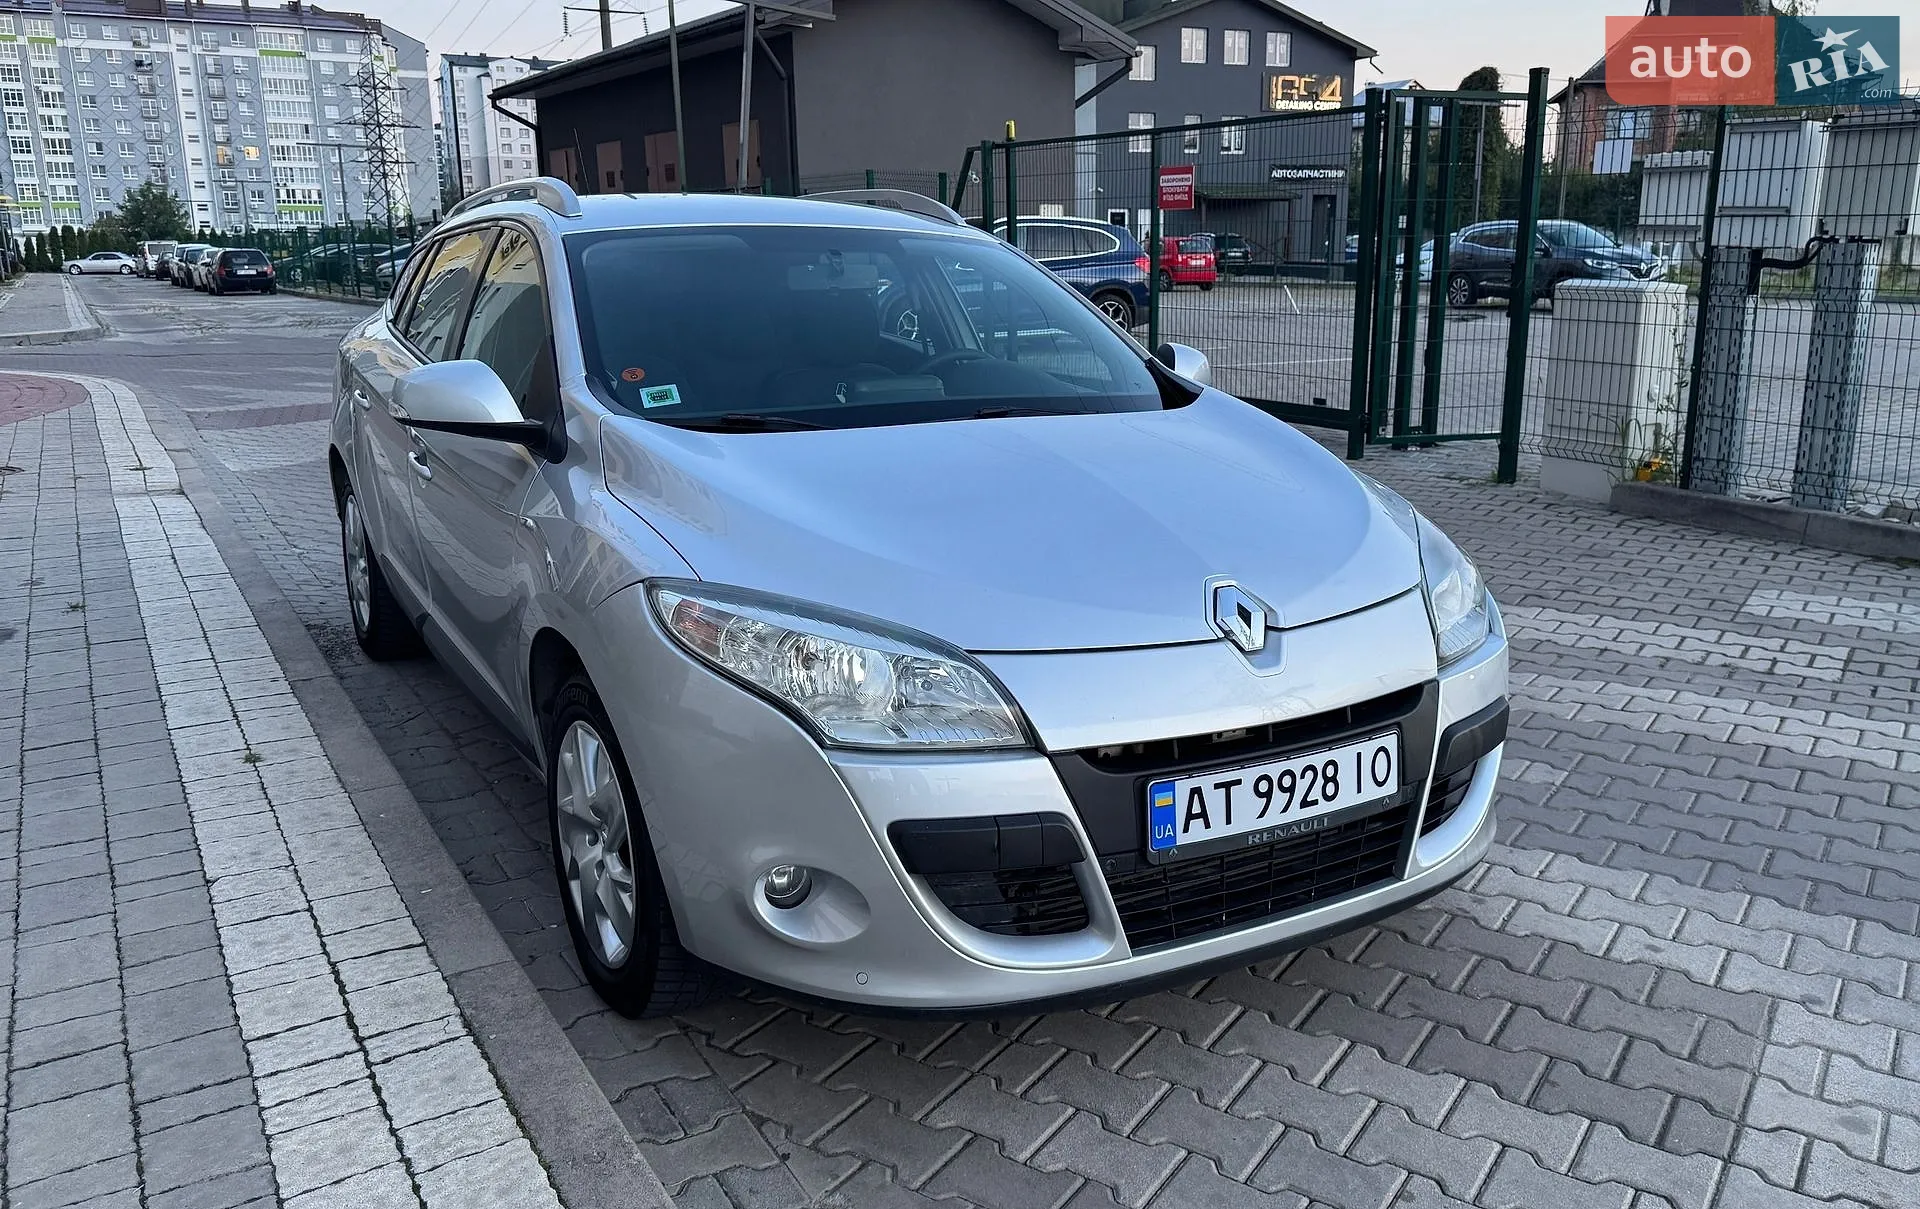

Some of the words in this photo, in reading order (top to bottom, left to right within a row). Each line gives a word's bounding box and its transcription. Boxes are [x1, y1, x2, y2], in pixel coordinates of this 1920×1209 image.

[1271, 169, 1346, 178] АВТОЗАПЧАСТИНИ
[1182, 778, 1242, 834] AT
[1253, 759, 1339, 820] 9928
[1356, 745, 1391, 794] IO
[1155, 824, 1175, 840] UA
[1248, 817, 1329, 845] RENAULT
